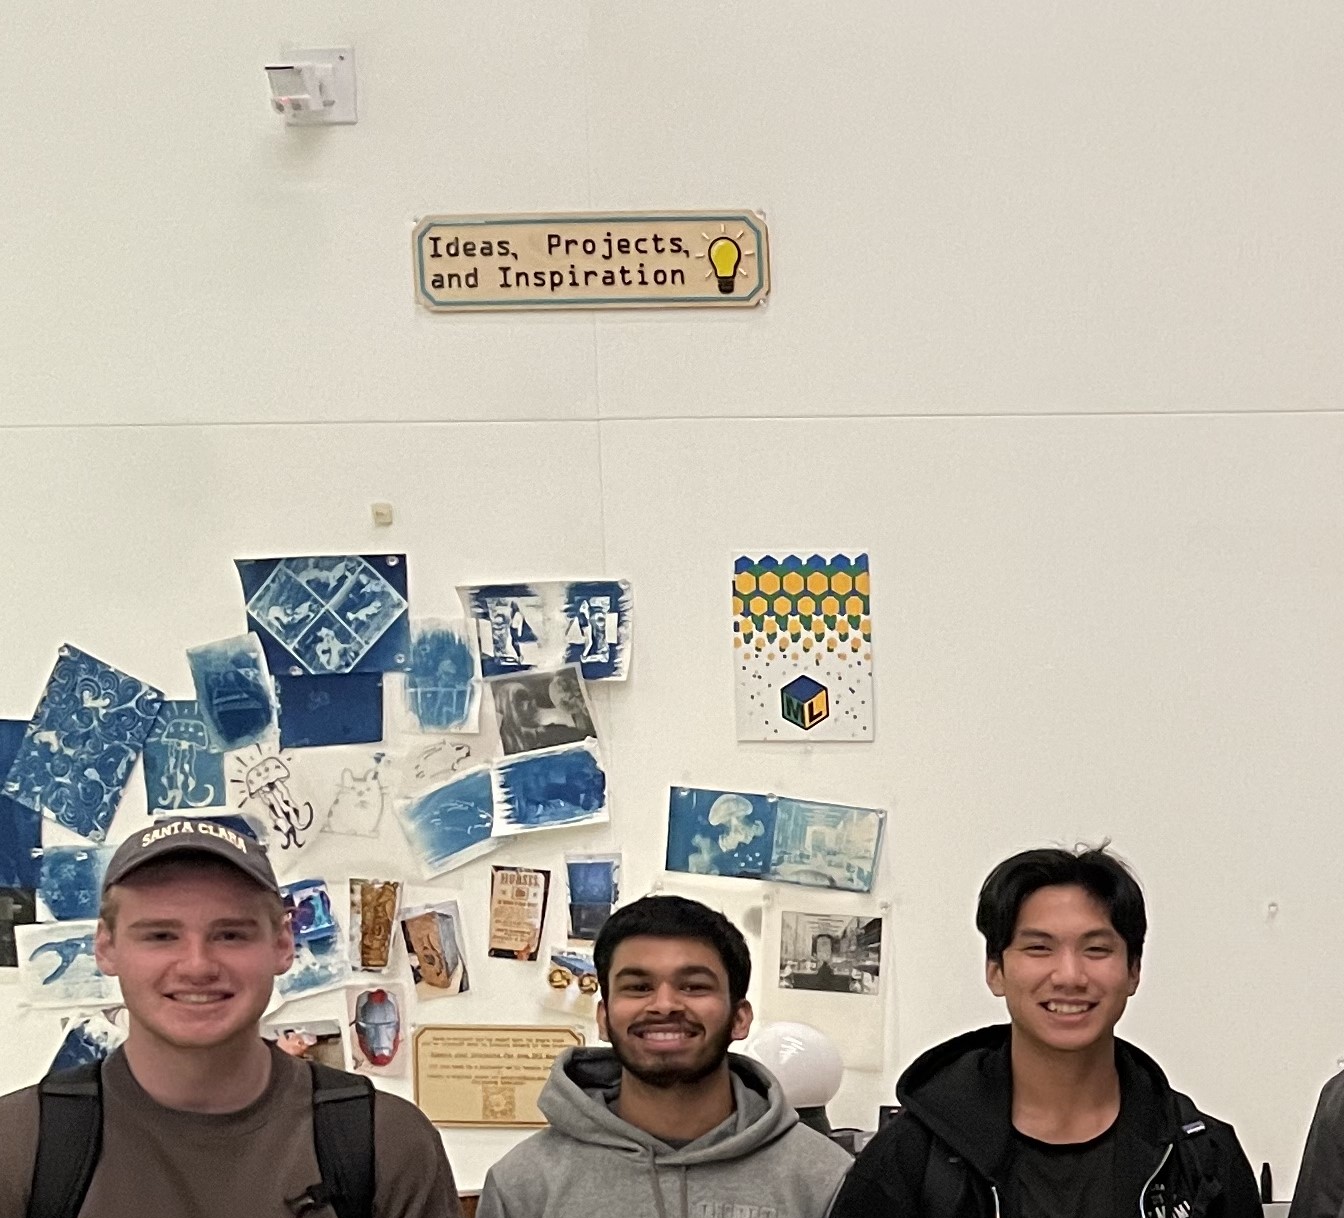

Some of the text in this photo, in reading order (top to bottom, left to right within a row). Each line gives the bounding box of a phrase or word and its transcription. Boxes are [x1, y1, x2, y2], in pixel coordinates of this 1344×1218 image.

[428, 232, 690, 260] Ideas, Projects,
[431, 263, 686, 291] and Inspiration
[141, 821, 248, 854] SANTA CLARA
